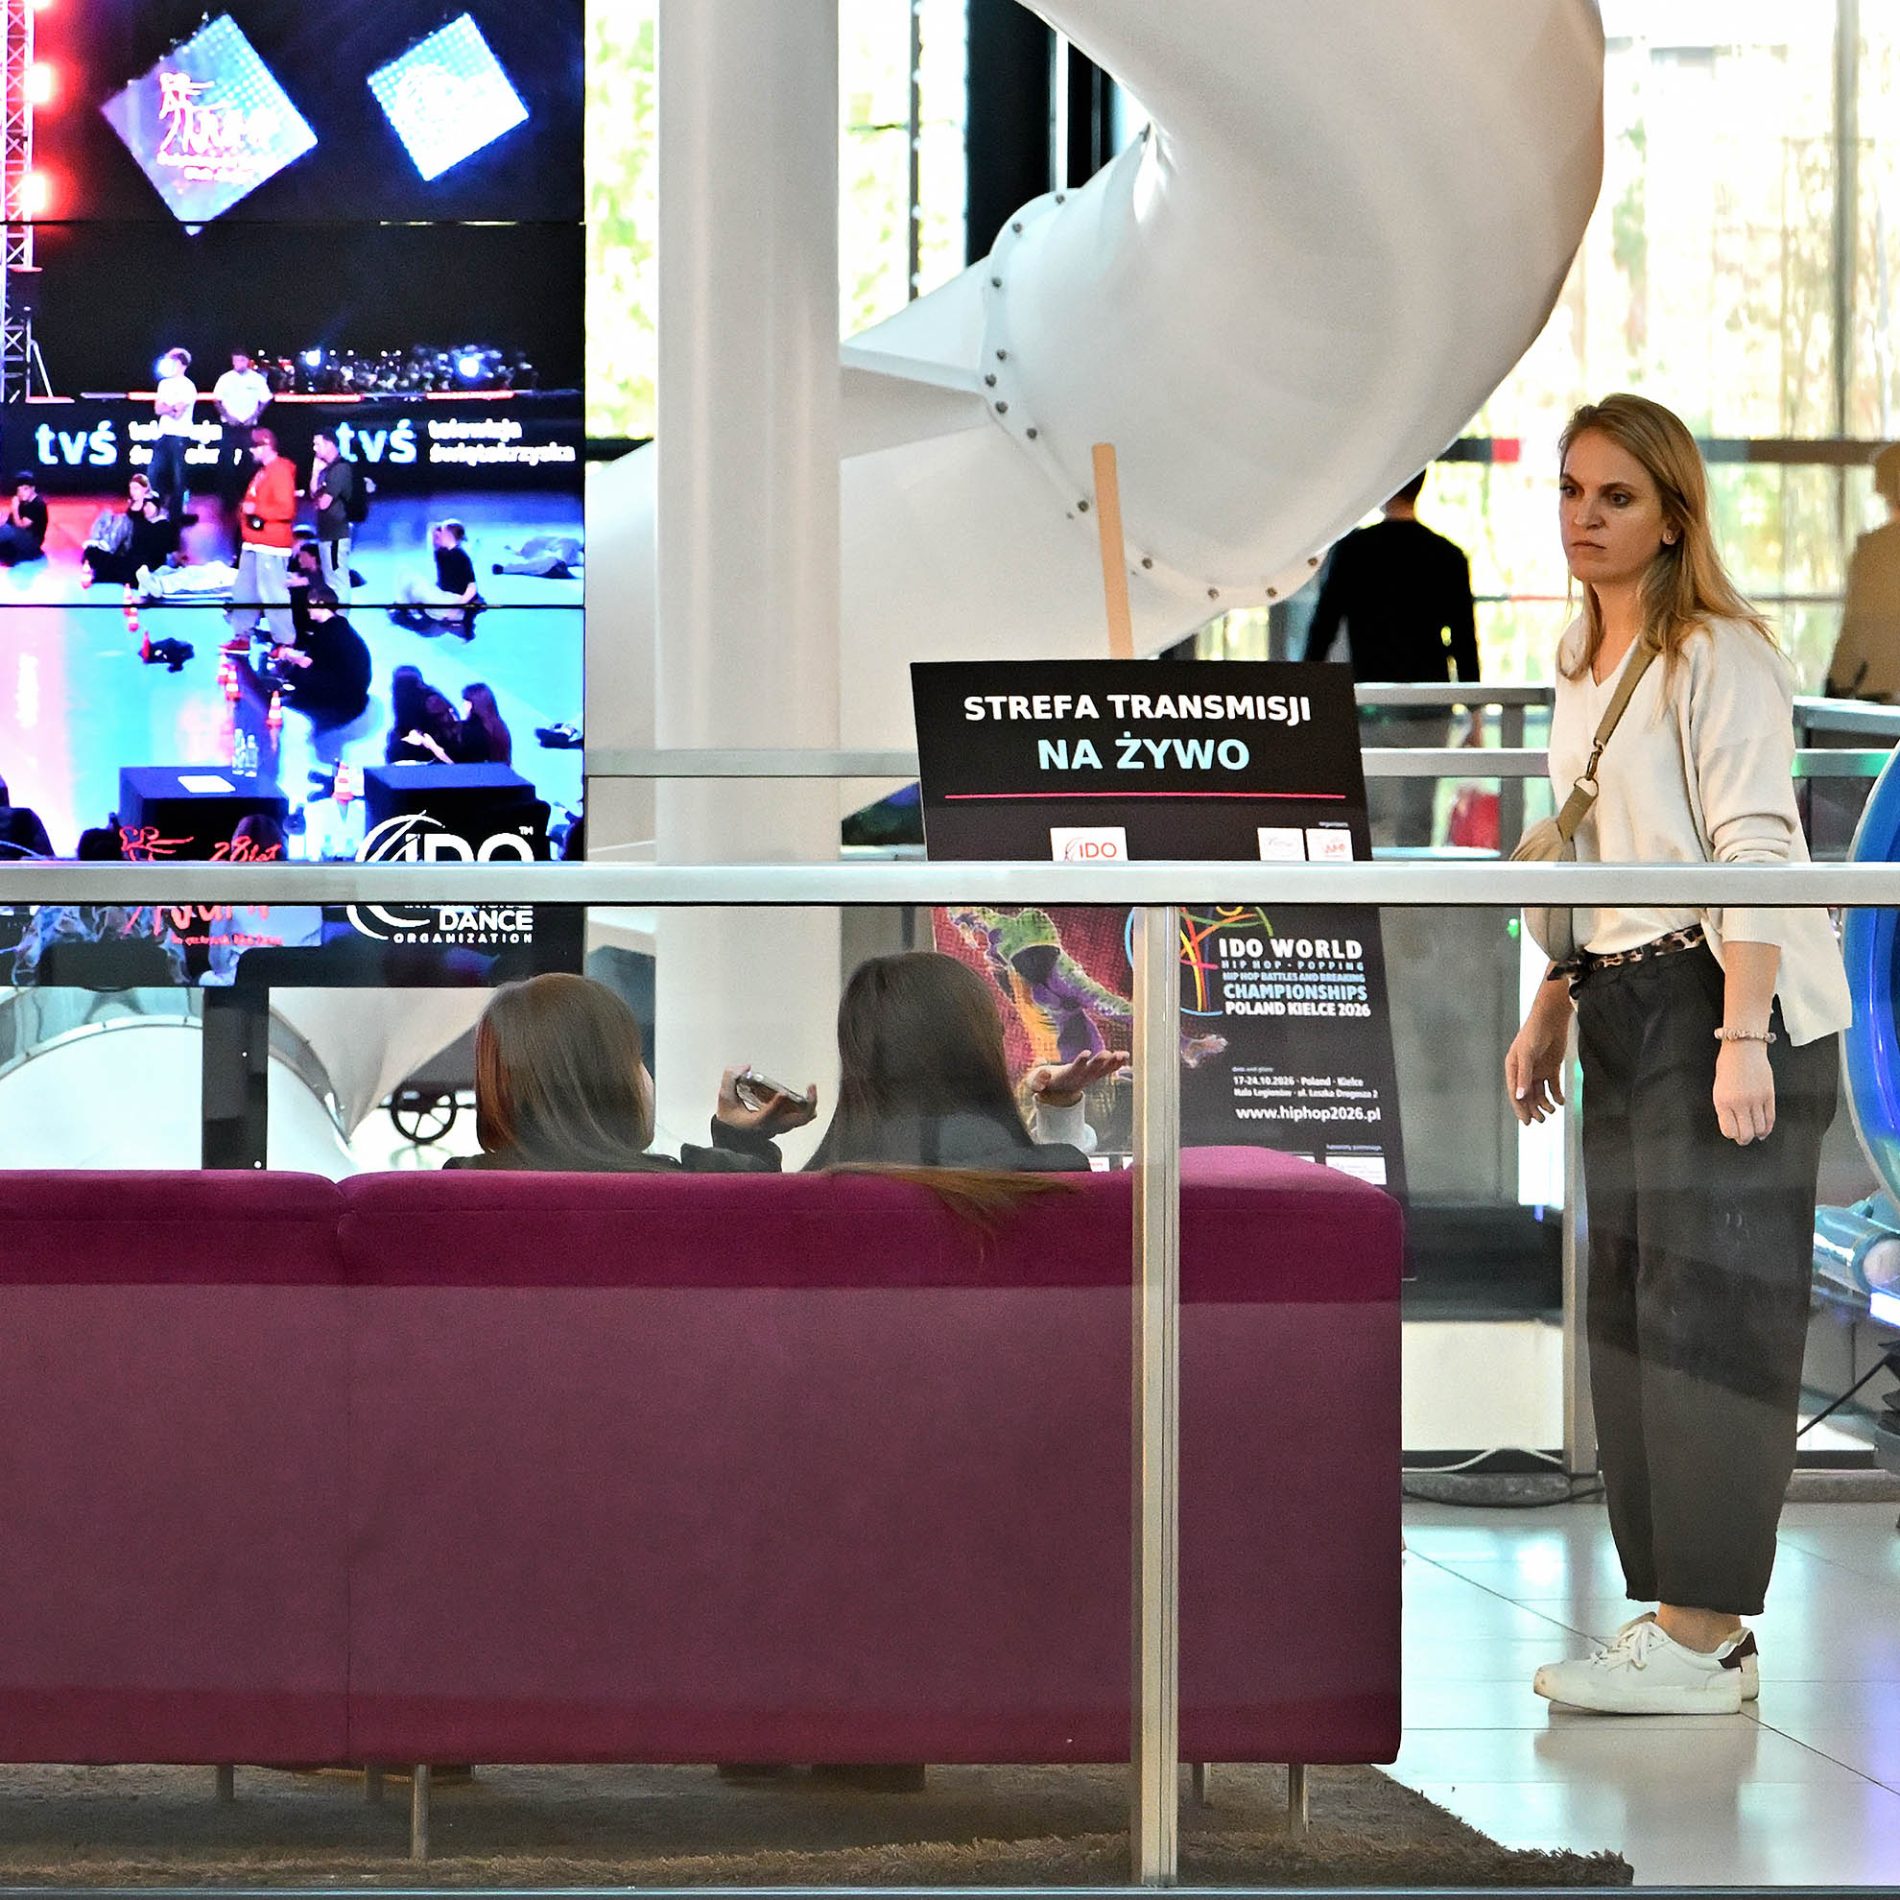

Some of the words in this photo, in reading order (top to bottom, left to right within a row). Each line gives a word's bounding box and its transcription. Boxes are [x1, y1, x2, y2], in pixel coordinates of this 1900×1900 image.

[35, 420, 117, 464] tvś
[334, 419, 417, 463] tvś
[964, 695, 1099, 720] STREFA
[1107, 695, 1311, 726] TRANSMISJI
[1038, 739, 1103, 769] NA
[1115, 731, 1249, 770] ŻYWO
[1079, 842, 1117, 858] IDO
[439, 910, 533, 931] DANCE
[394, 933, 532, 943] ORGANIZATION
[1219, 938, 1263, 958] IDO
[1270, 939, 1362, 959] WORLD
[1222, 960, 1247, 969] HIP
[1252, 960, 1281, 969] HOP
[1298, 961, 1363, 971] POPPING
[1223, 972, 1239, 980] HIP
[1240, 972, 1260, 980] HOP
[1261, 972, 1298, 981] BATTLES
[1299, 973, 1319, 981] AND
[1320, 973, 1365, 982] BREAKING
[1223, 984, 1368, 1001] CHAMPIONSHIPS
[1225, 1002, 1286, 1016] POLAND
[1287, 1002, 1336, 1016] KIELCE
[1338, 1003, 1371, 1017] 2026
[1234, 1076, 1295, 1085] 17-24.10.2026
[1301, 1077, 1331, 1086] Poland
[1337, 1077, 1363, 1086] Kielce
[1236, 1105, 1381, 1123] www.hiphop2026.pl
